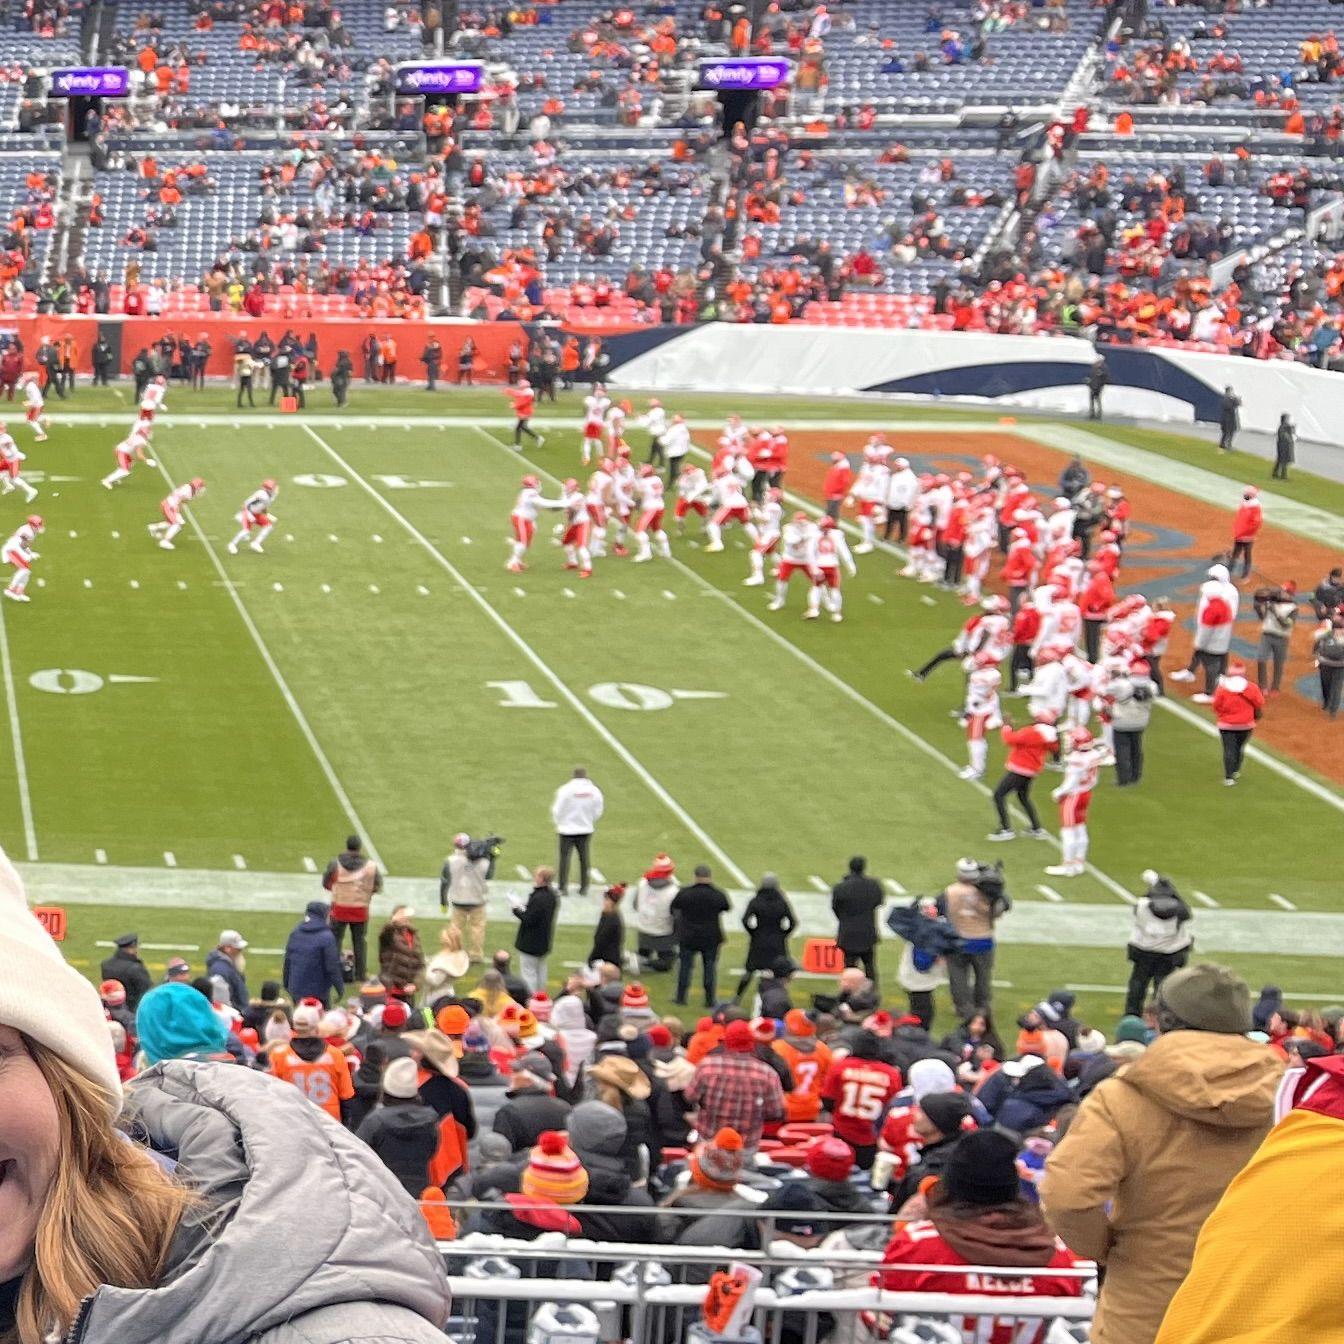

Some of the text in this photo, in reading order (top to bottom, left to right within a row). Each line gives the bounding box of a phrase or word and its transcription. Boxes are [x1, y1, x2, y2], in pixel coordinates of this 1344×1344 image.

[487, 679, 674, 712] 10
[813, 944, 836, 969] 10
[291, 1071, 332, 1104] 18
[795, 1061, 819, 1095] 7
[841, 1085, 888, 1120] 15
